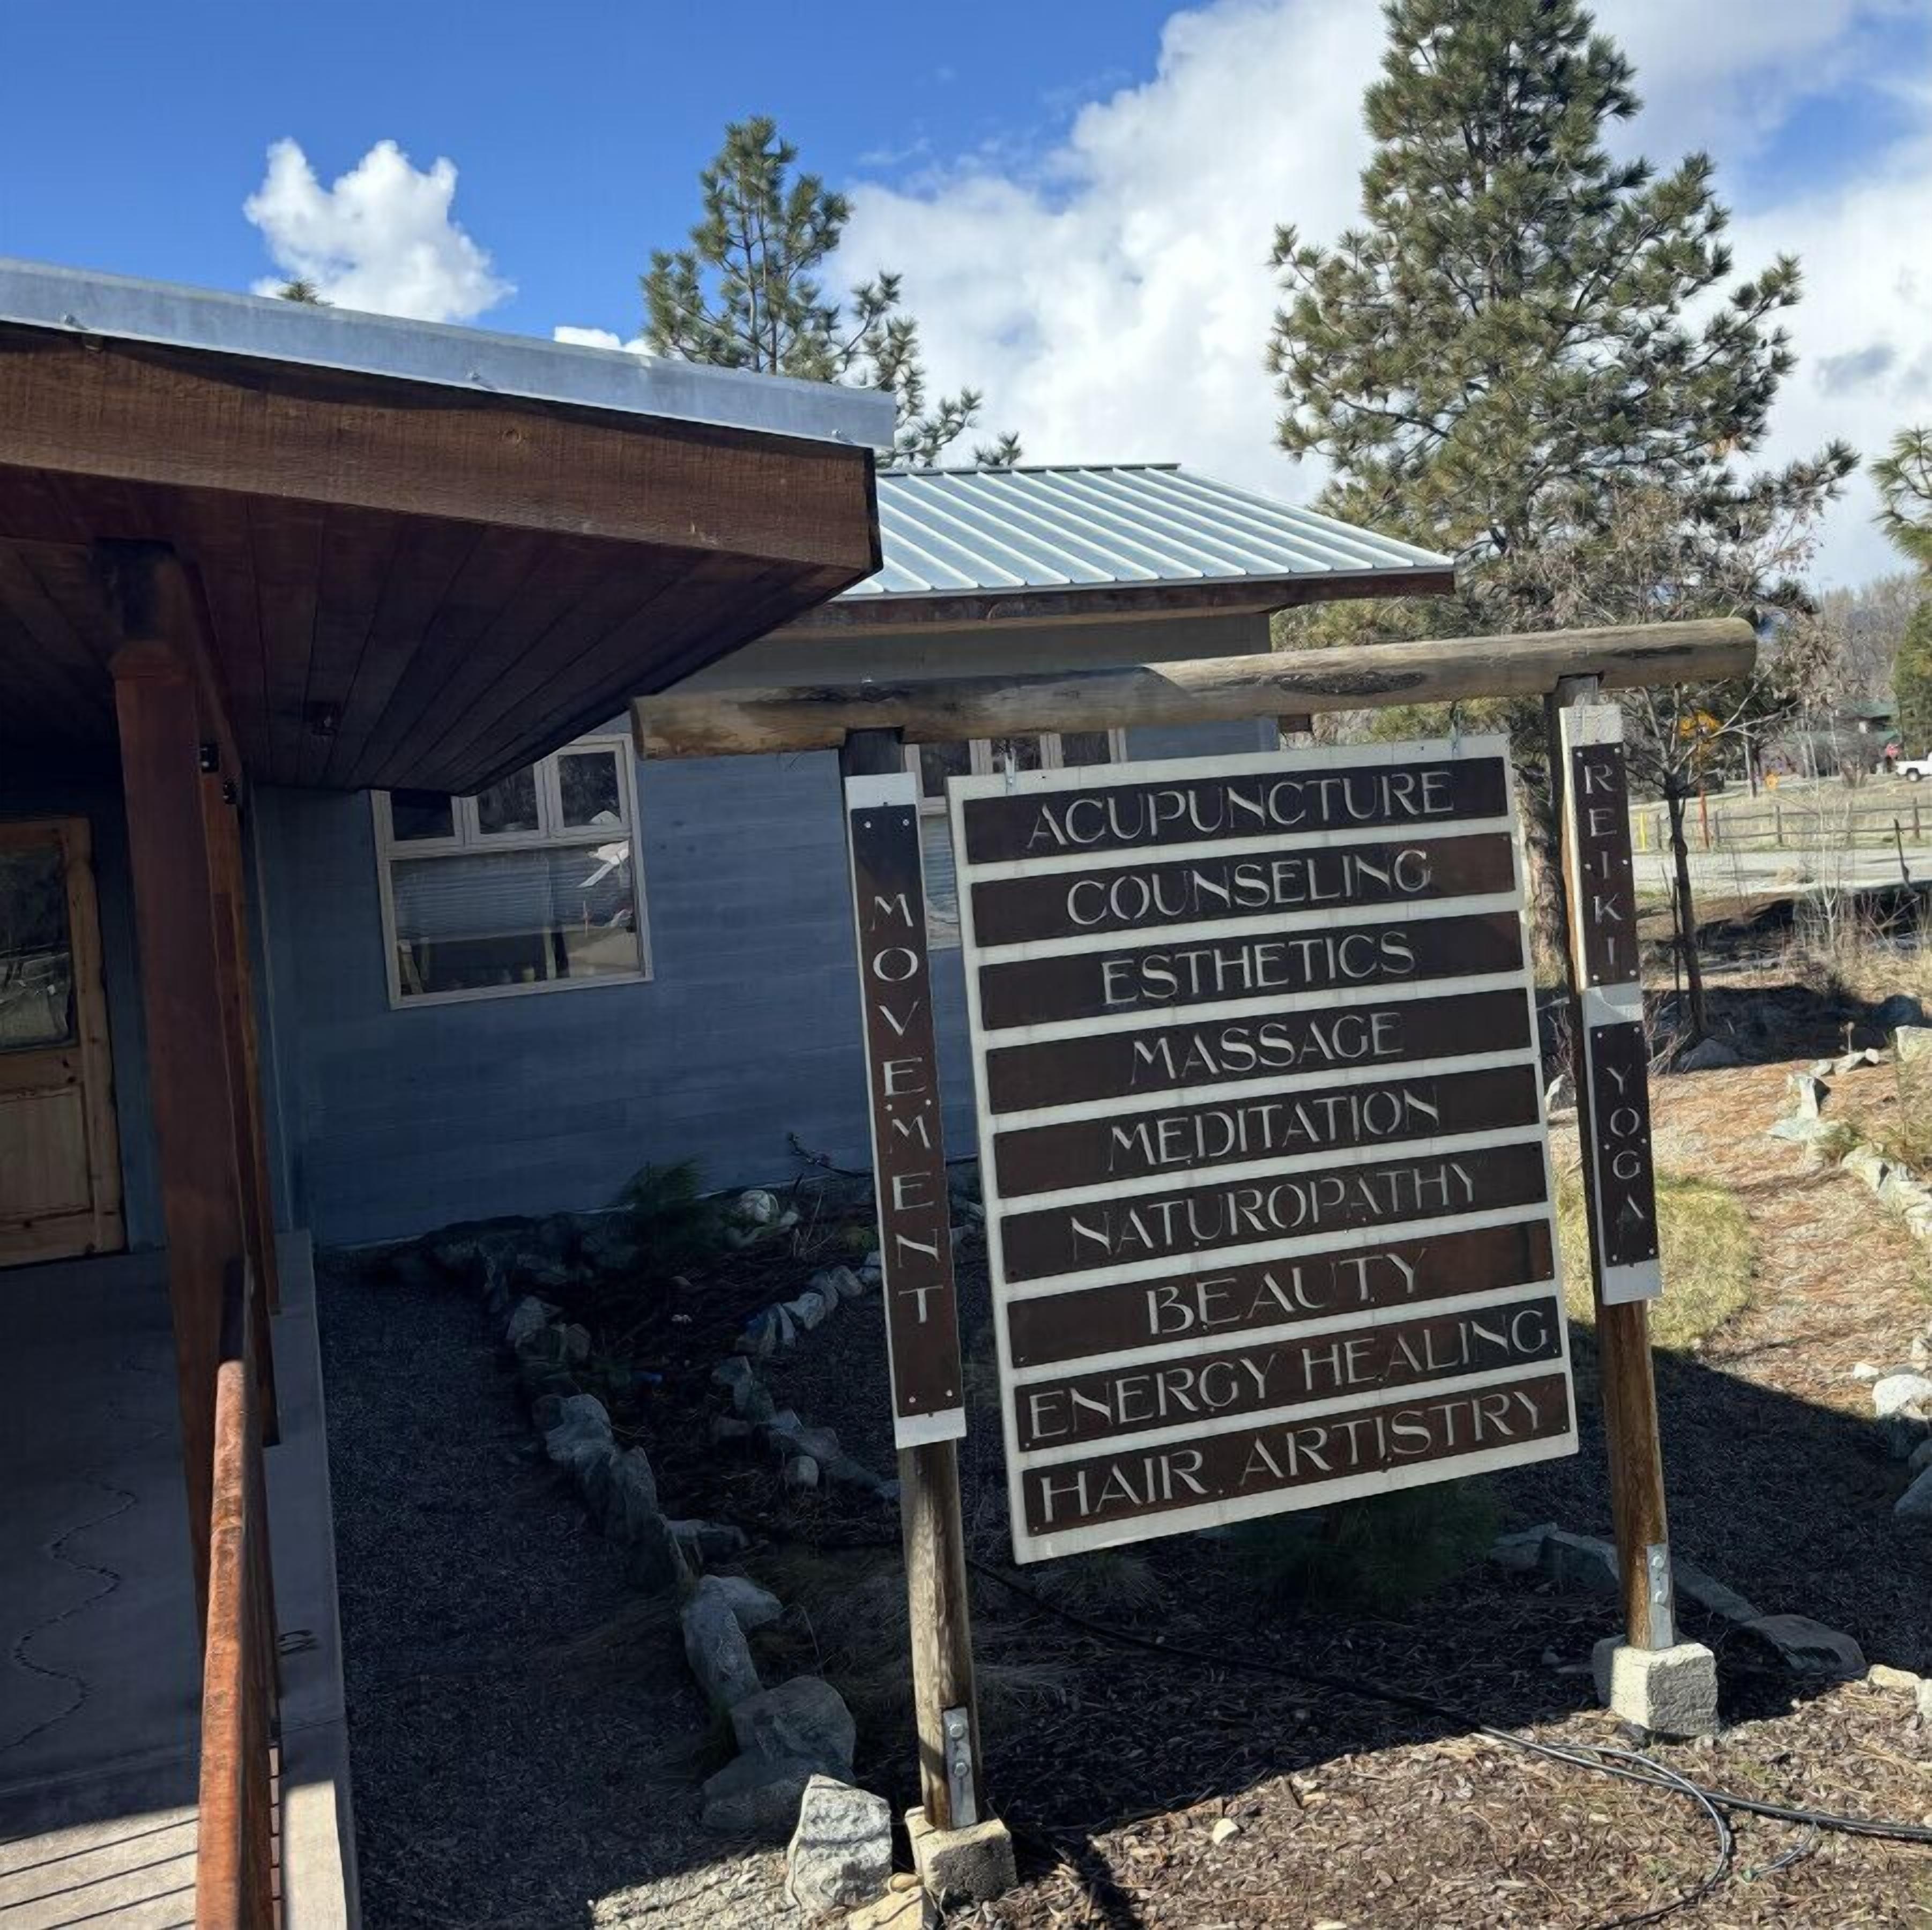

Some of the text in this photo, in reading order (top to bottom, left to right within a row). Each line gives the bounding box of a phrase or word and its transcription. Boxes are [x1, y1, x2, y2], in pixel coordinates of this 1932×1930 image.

[1027, 770, 1455, 850] ACUPUNCTURE
[1066, 849, 1431, 926] COUNSELING
[1584, 764, 1623, 964] REIKI
[1101, 931, 1416, 1006] ESTHETICS
[1131, 1012, 1403, 1085] MASSAGE
[870, 892, 944, 1324] MOVEMENT
[1109, 1085, 1440, 1172] MEDITATION
[1607, 1064, 1646, 1223] YOGA
[1071, 1161, 1477, 1259] NATUROPATHY
[1146, 1248, 1427, 1336] BEAUTY
[1029, 1309, 1548, 1441] ENERGY HEALING
[1040, 1387, 1549, 1524] HAIR ARTISTRY
